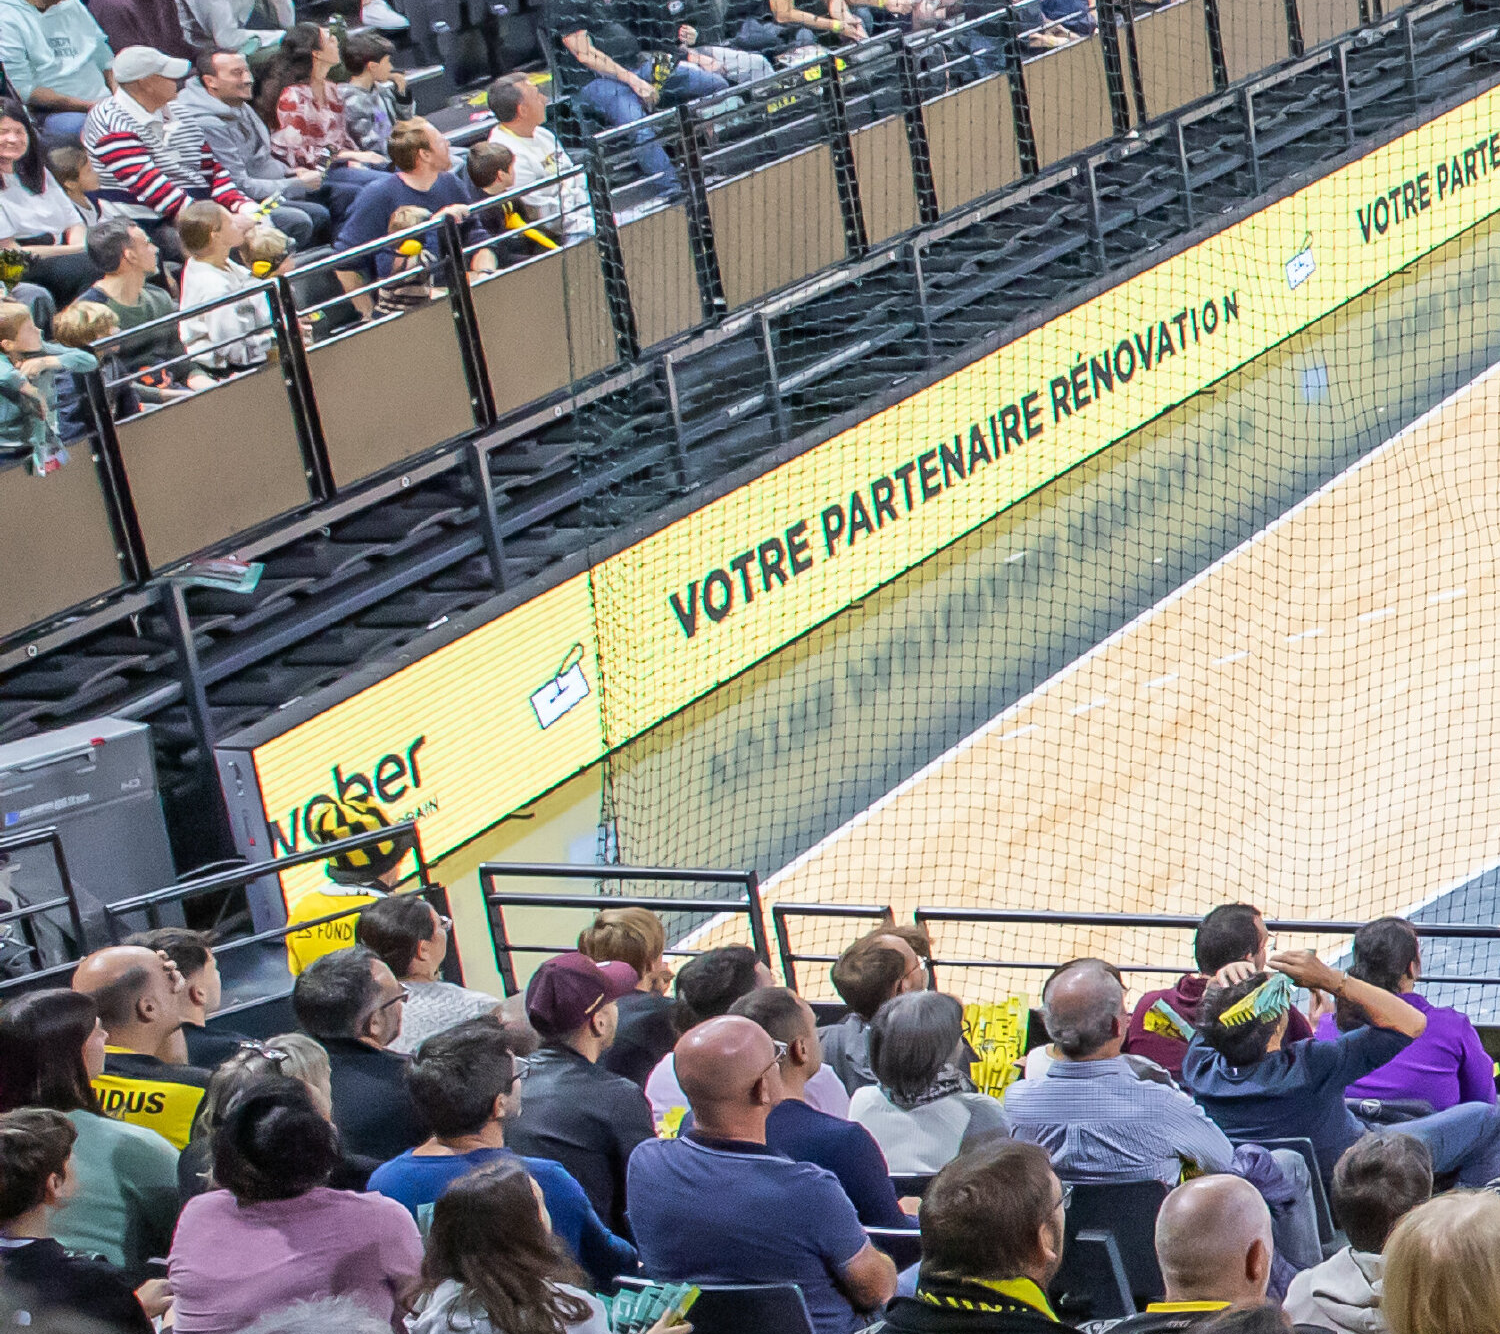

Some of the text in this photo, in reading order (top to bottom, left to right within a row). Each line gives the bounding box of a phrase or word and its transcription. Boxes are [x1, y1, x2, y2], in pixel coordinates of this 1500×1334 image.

[1356, 171, 1431, 244] VOTRE
[670, 291, 1241, 638] VOTRE PARTENAIRE RÉNOVATION
